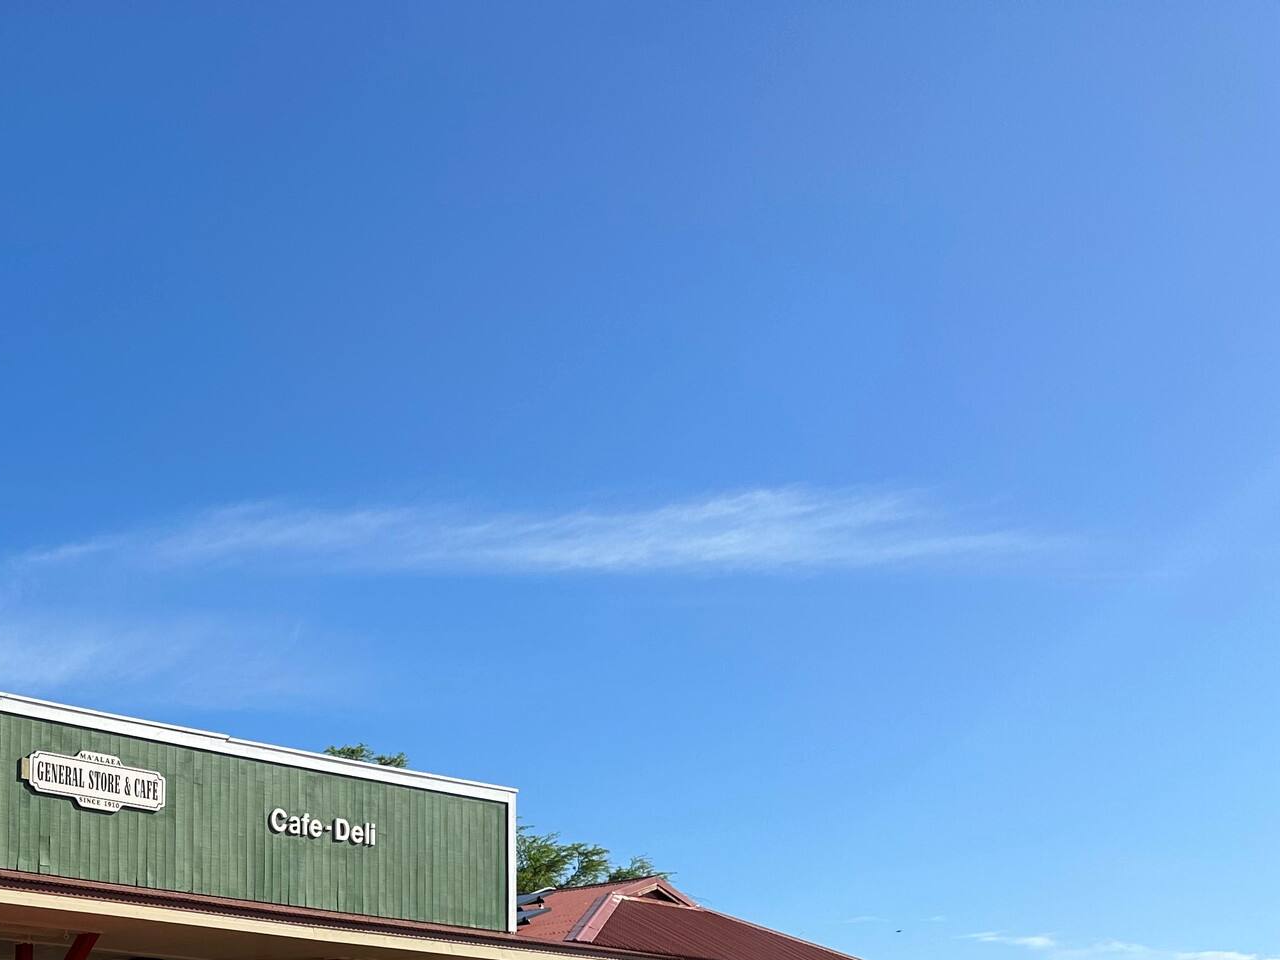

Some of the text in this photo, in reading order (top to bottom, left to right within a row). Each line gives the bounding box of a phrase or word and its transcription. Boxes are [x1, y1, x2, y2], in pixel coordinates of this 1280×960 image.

[37, 761, 159, 801] GENERAL STORE & CAFÉ
[79, 797, 120, 809] SINCE 1910
[270, 807, 376, 846] Cafe-Deli
